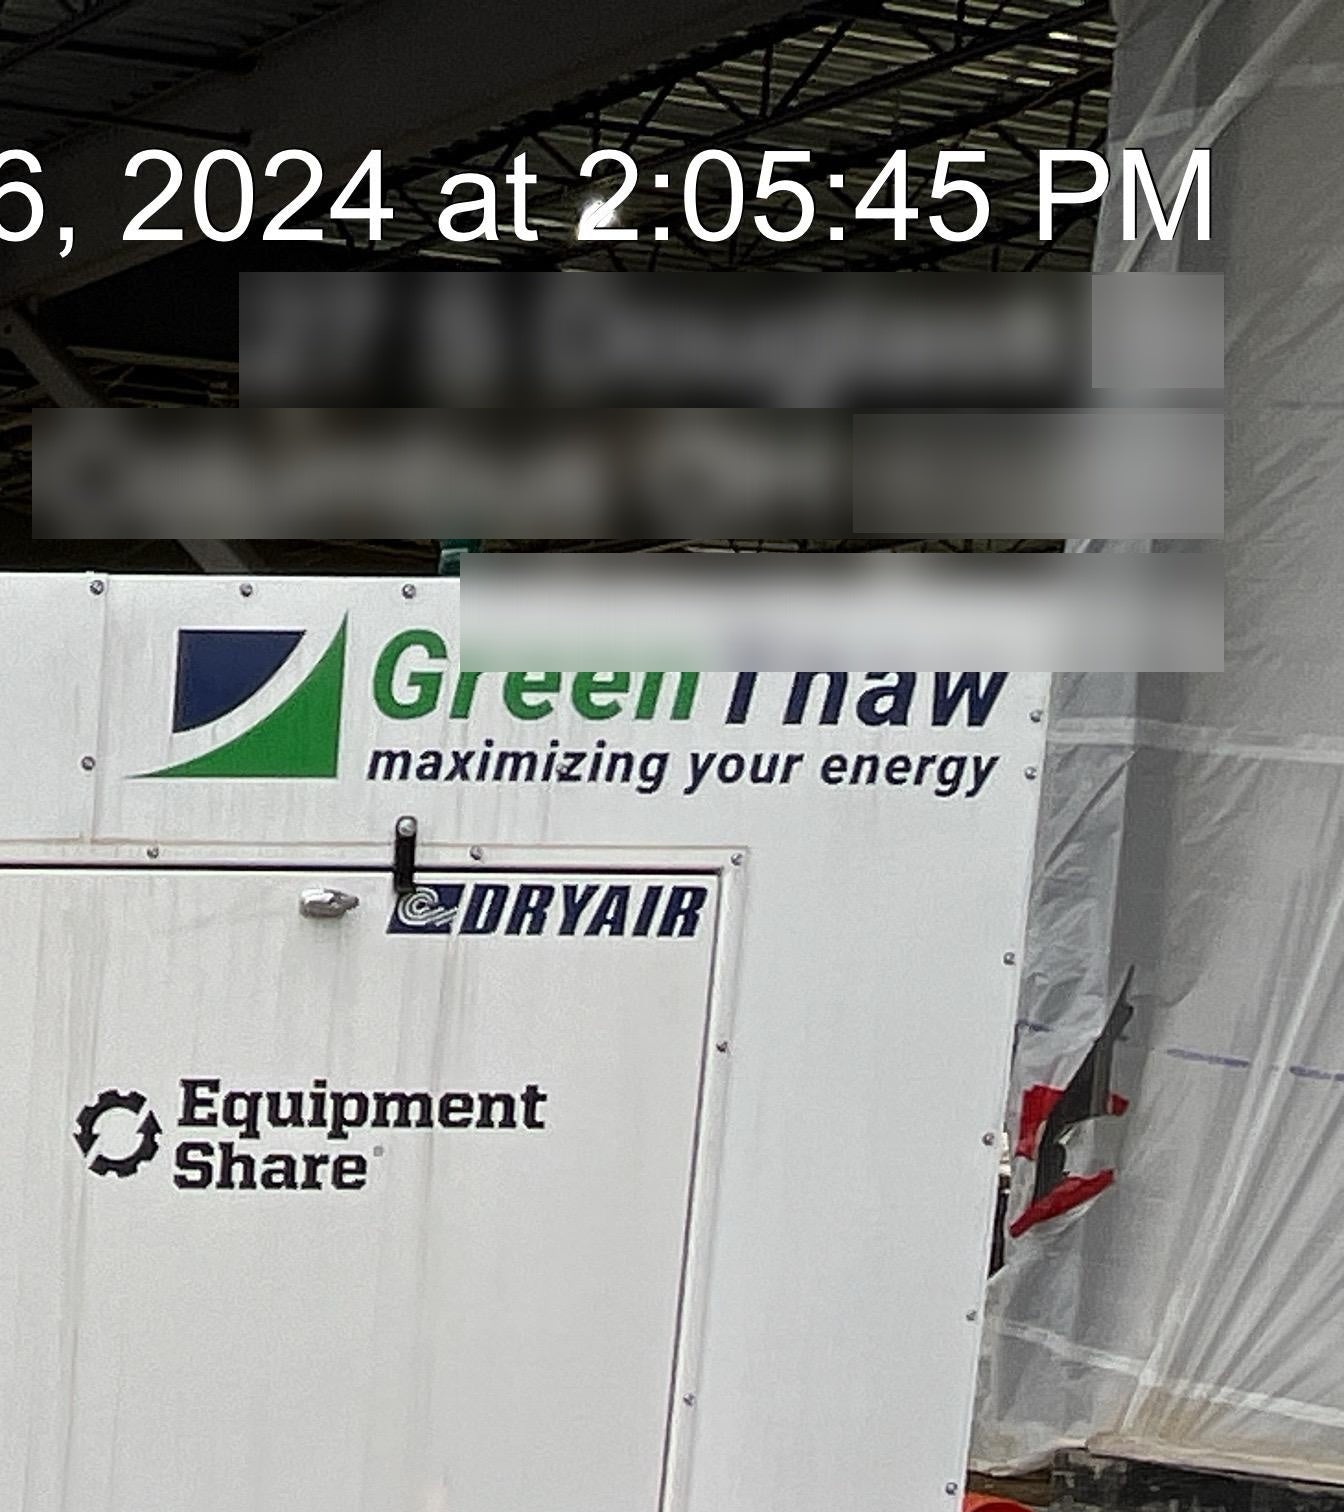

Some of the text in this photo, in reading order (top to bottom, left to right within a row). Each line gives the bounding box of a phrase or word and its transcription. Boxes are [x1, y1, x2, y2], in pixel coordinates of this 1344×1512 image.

[368, 738, 999, 797] maximizing your energy
[459, 884, 708, 936] DRYAIR
[176, 1078, 548, 1140] Equipment
[173, 1141, 368, 1191] Share
